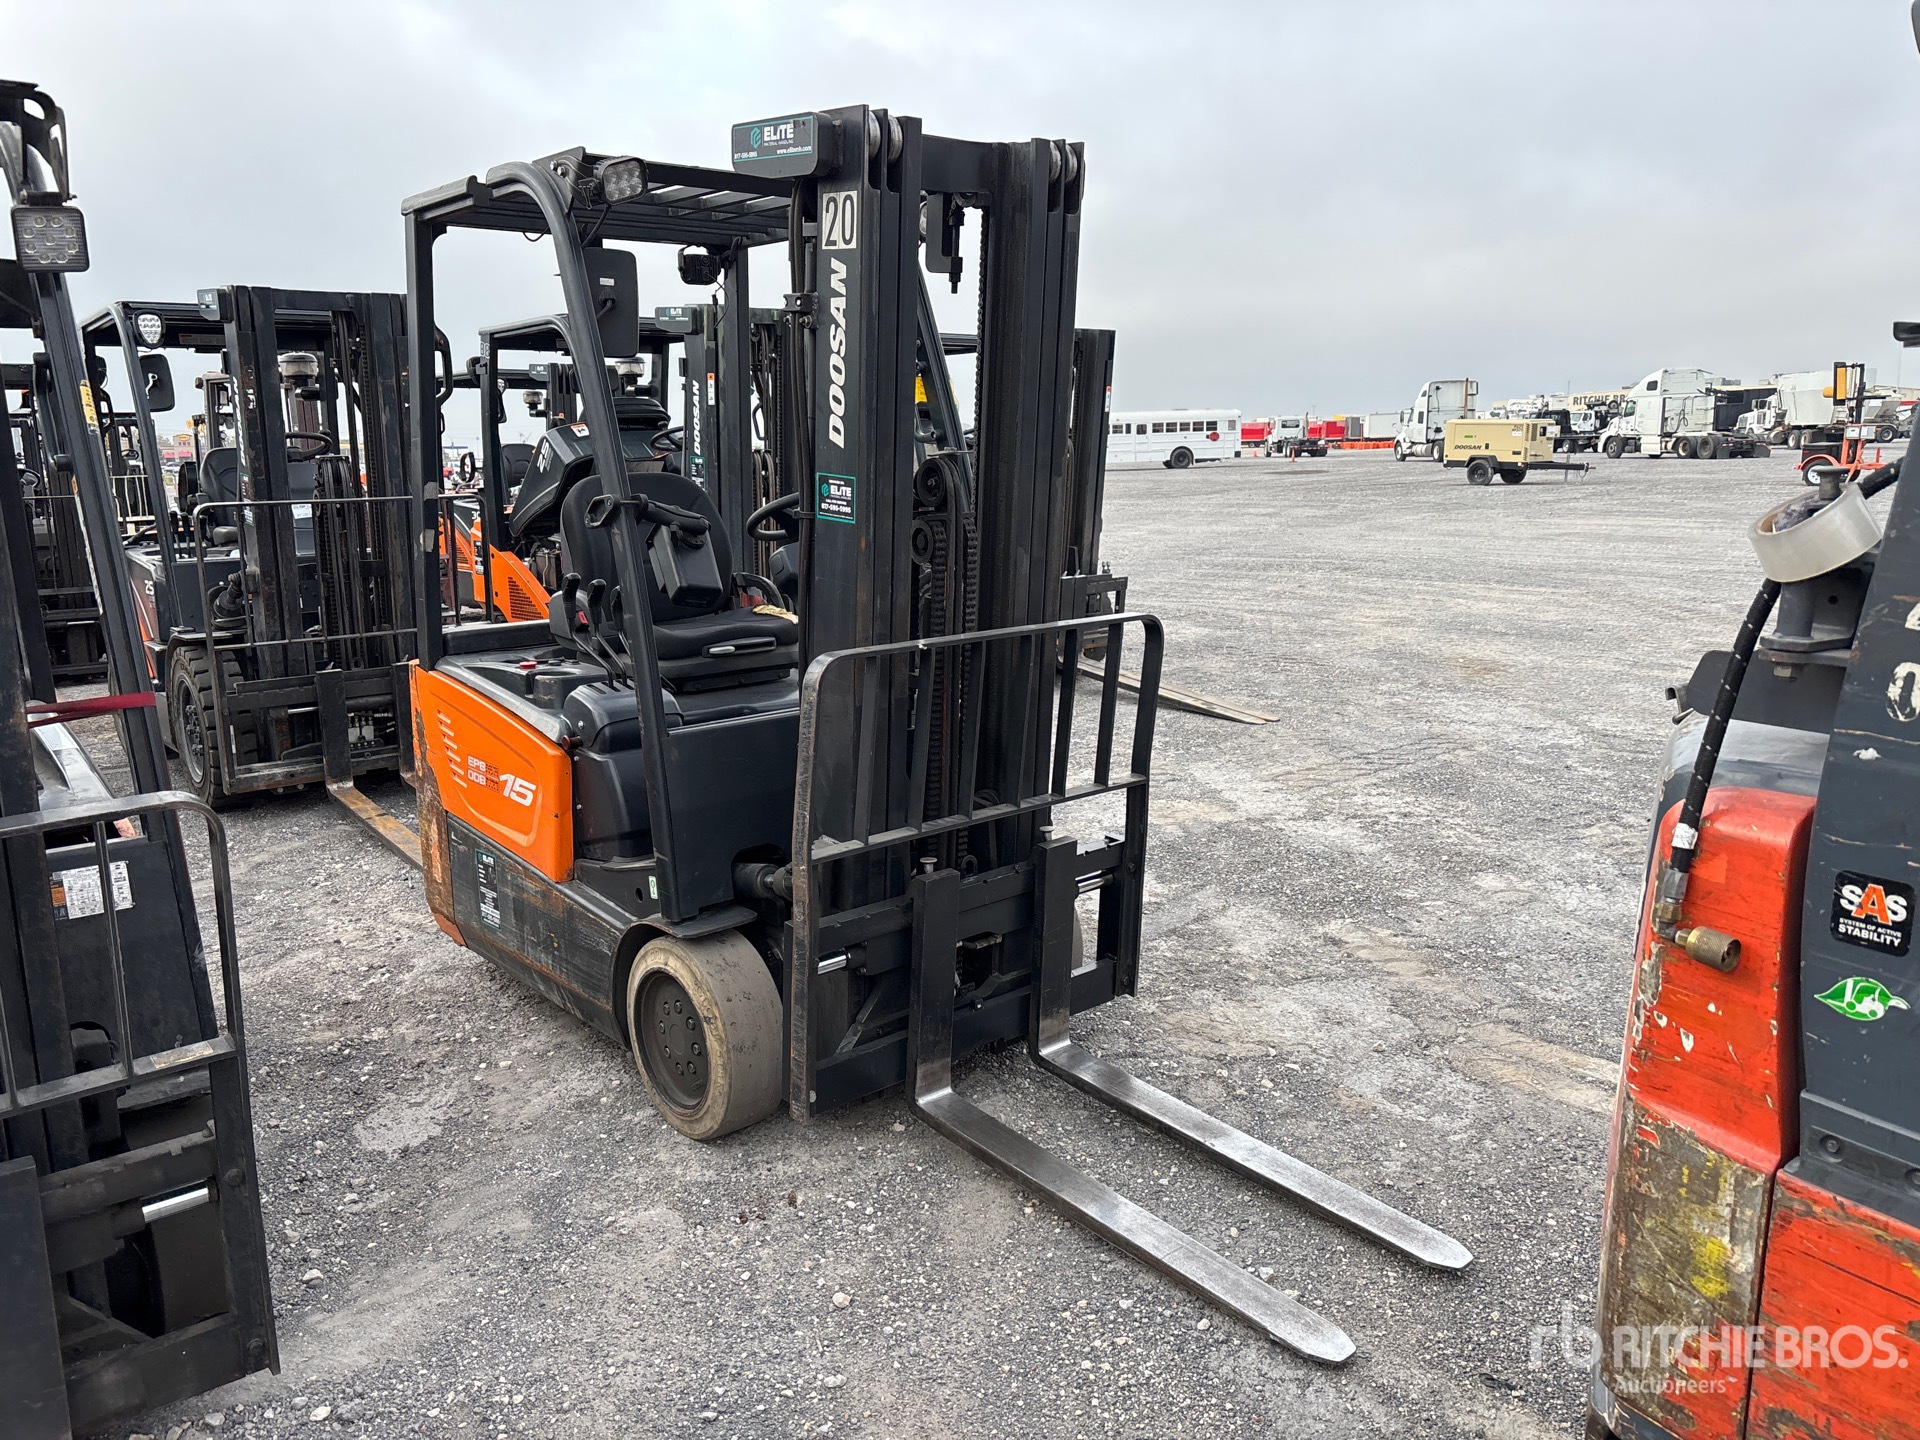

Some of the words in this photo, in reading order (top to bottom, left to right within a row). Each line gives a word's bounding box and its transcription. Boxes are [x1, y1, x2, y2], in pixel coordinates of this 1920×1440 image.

[764, 124, 794, 141] ELITE
[824, 193, 856, 248] 20
[829, 257, 847, 449] DOOSAN
[692, 380, 701, 456] DOOSAN
[537, 438, 550, 473] 25
[830, 485, 852, 497] ELITE
[467, 755, 486, 772] EPB
[499, 773, 536, 807] 15
[1840, 883, 1907, 925] SAS
[1838, 924, 1901, 946] STABILITY
[1839, 918, 1866, 928] SYSTEM
[1877, 927, 1902, 938] ACTIVE
